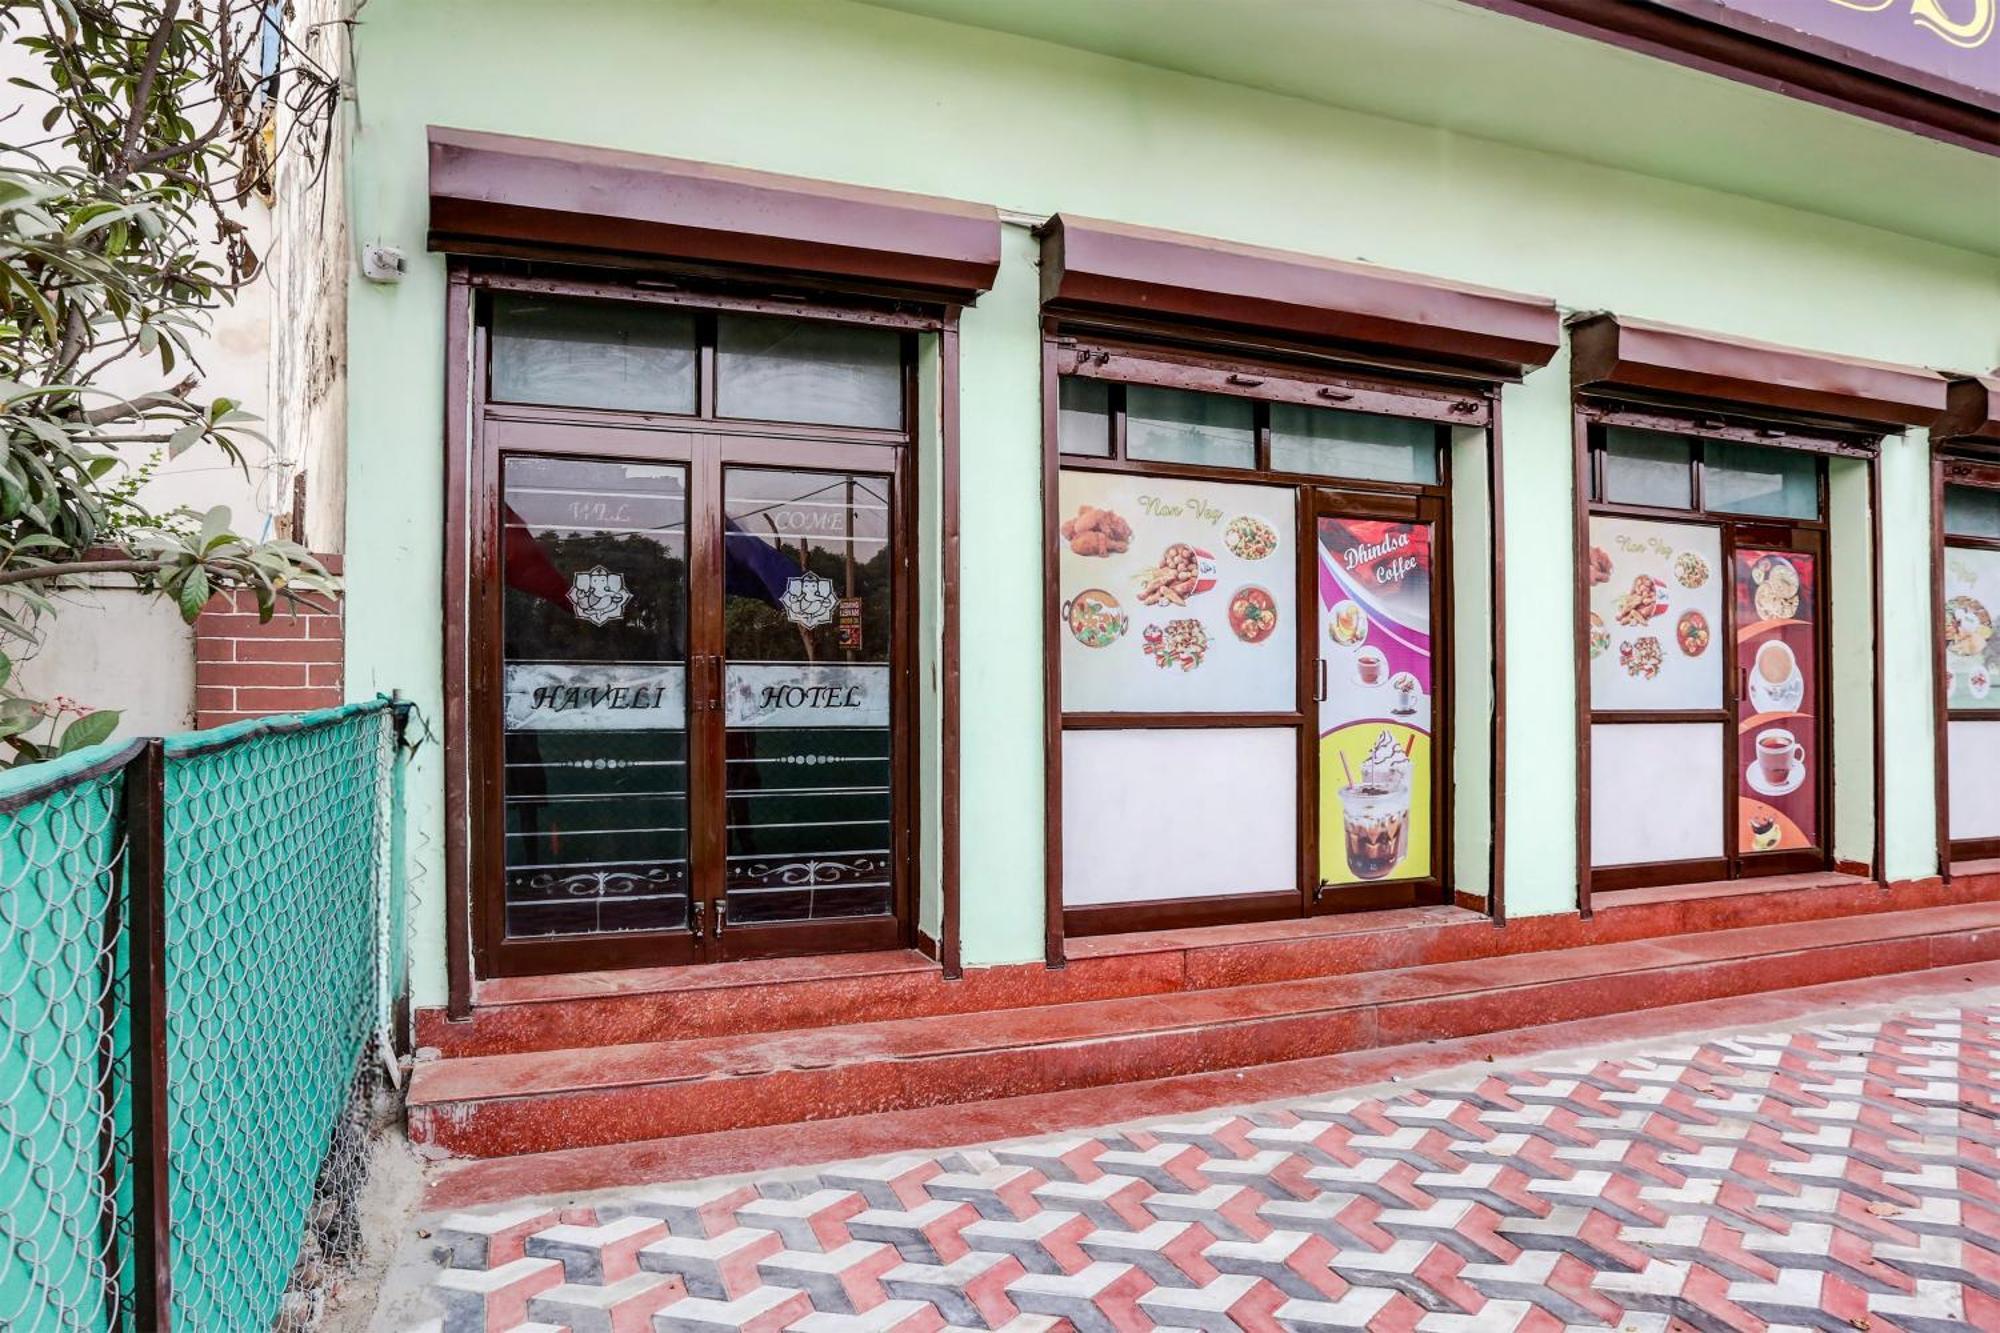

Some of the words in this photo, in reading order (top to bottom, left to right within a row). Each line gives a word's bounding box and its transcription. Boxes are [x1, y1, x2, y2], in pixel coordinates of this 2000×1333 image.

[775, 510, 844, 530] COME
[1138, 495, 1183, 516] Non
[1185, 498, 1223, 525] Veg
[1343, 532, 1409, 571] Dhindsa
[1376, 555, 1417, 584] Coffee
[531, 684, 666, 712] HAVELI
[760, 684, 861, 709] HOTEL
